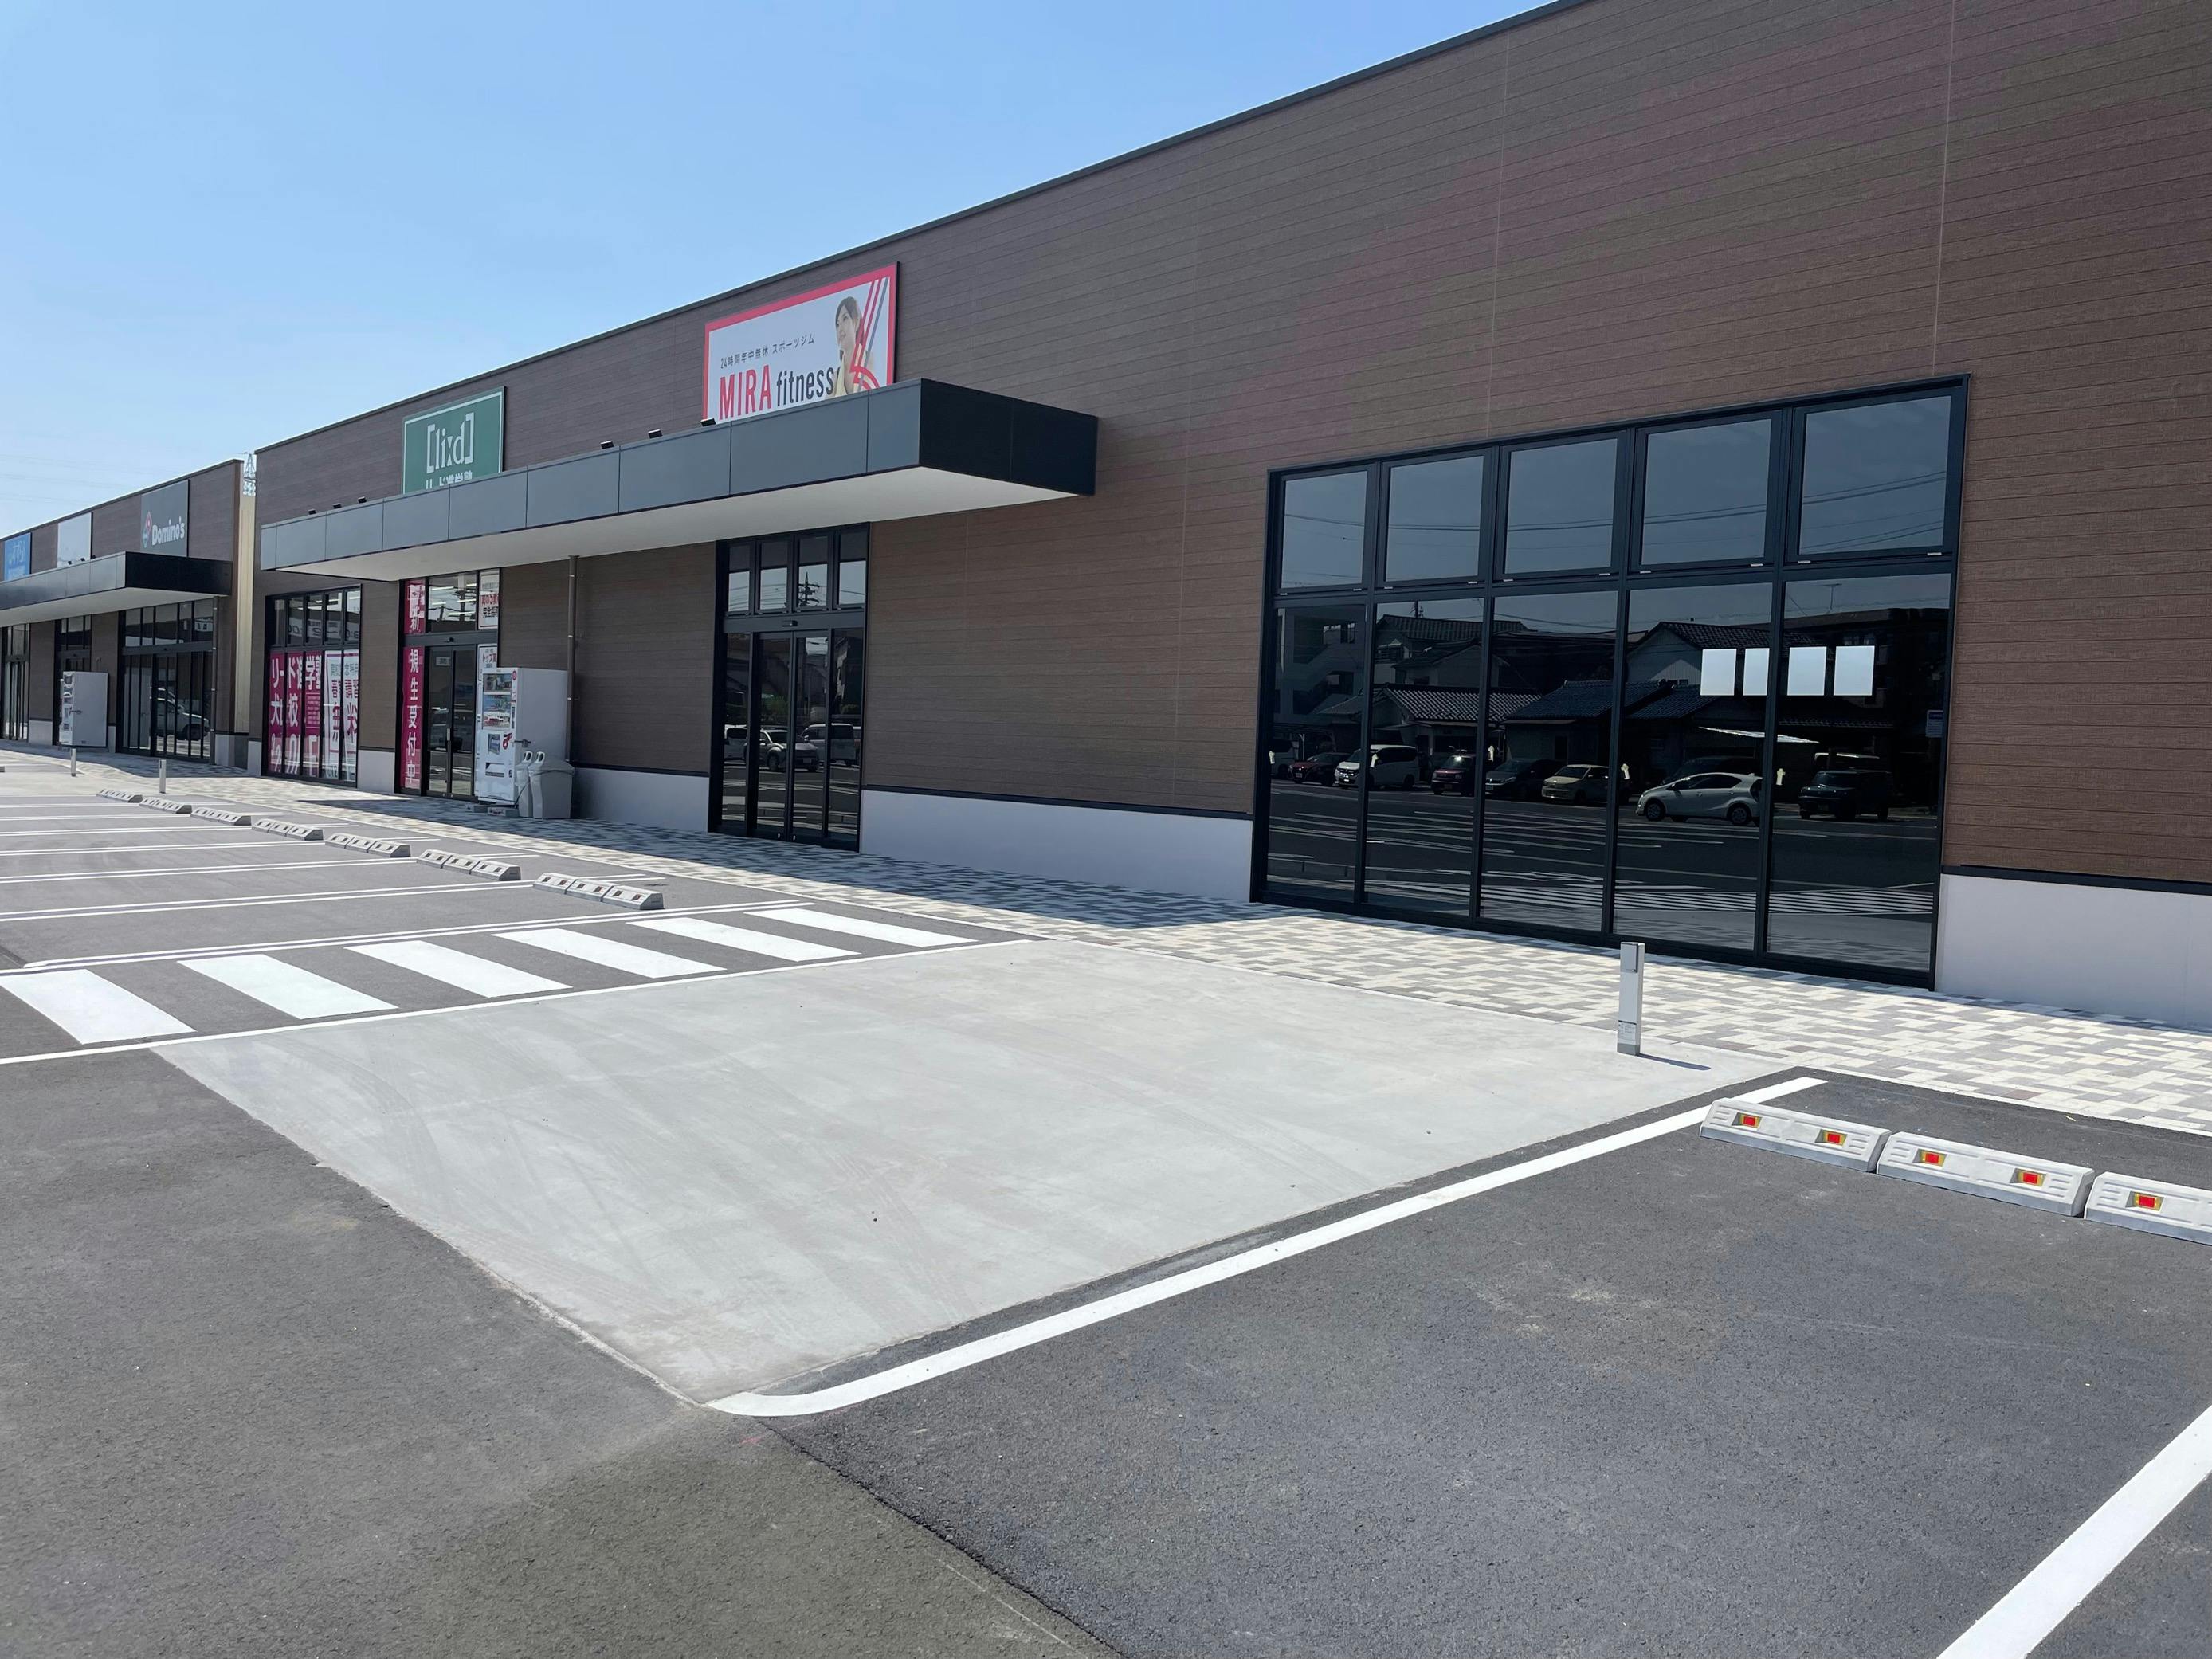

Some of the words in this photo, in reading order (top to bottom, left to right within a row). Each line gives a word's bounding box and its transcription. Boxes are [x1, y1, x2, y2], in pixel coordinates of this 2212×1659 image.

[772, 333, 814, 354] スポーツジム
[719, 363, 772, 421] MIRA
[776, 367, 834, 407] fitness
[151, 516, 185, 546] Domino's
